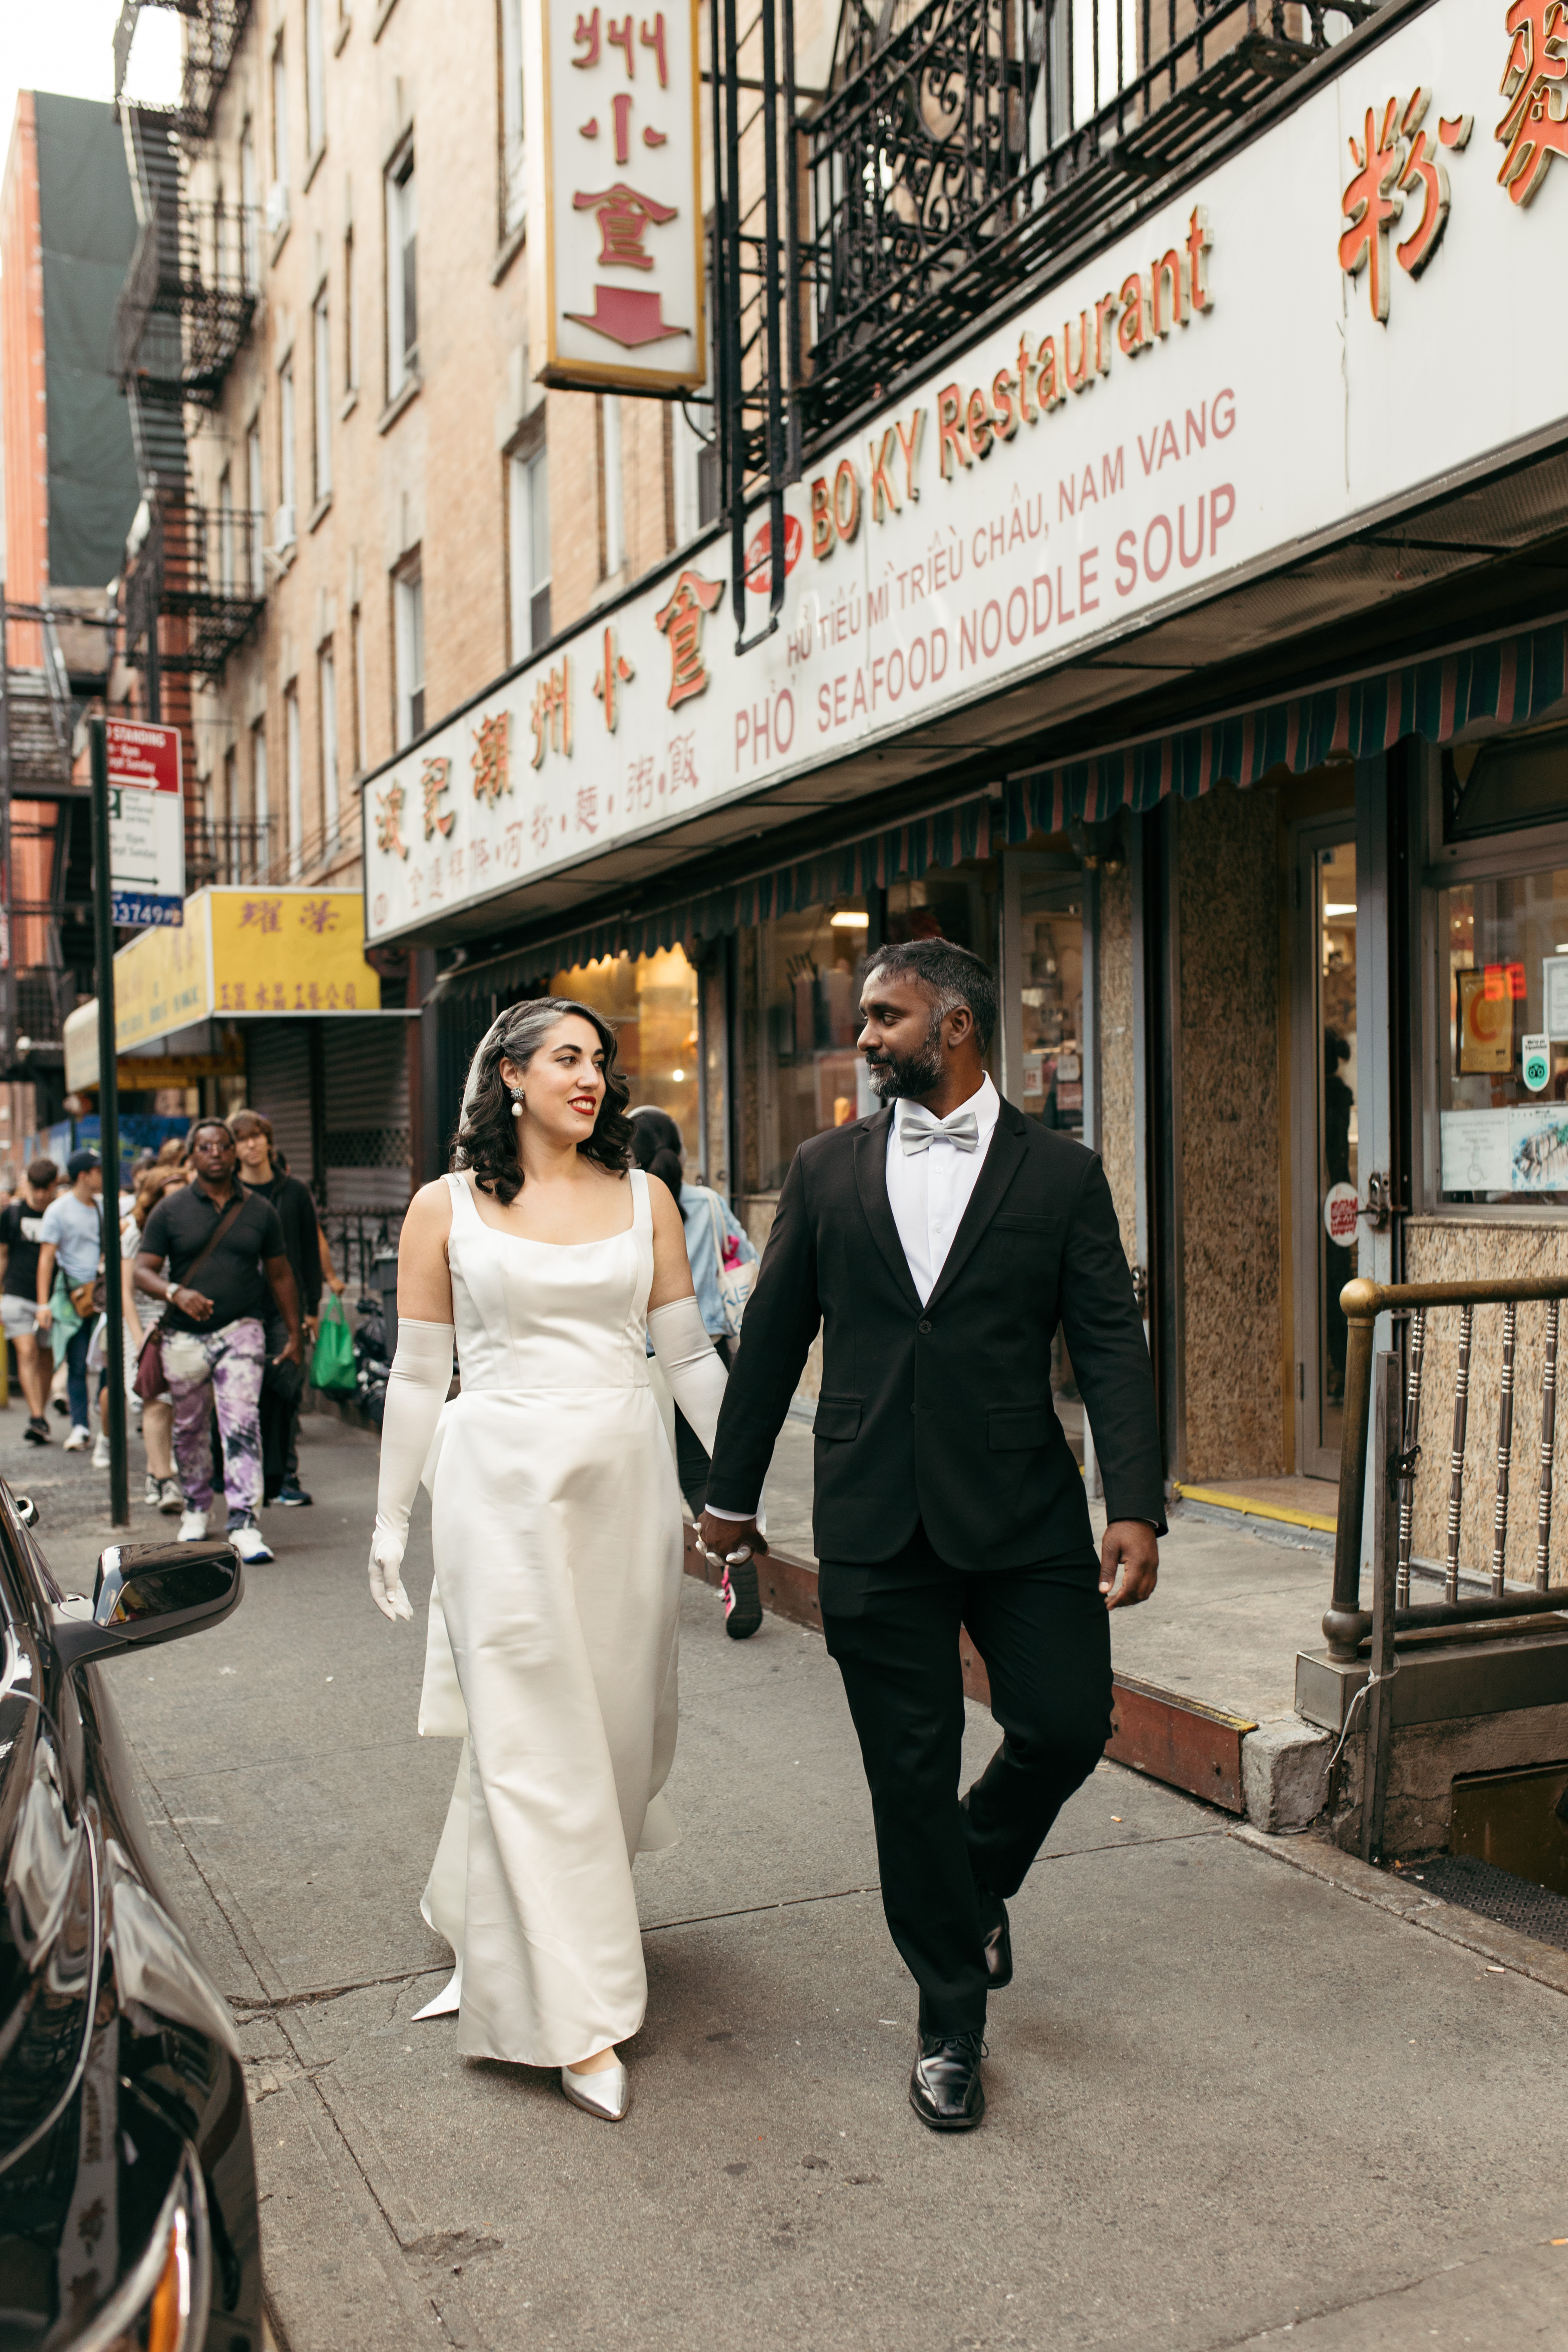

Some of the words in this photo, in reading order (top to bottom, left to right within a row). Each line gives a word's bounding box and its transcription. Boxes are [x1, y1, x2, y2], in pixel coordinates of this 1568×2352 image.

[812, 459, 864, 561] BO
[870, 407, 928, 524] KY
[937, 204, 1215, 482] Restaurant
[1060, 445, 1124, 522] NAM
[1137, 388, 1237, 476] VANG
[818, 627, 948, 733] SEAFOOD
[959, 546, 1100, 671] NOODLE
[1115, 482, 1237, 598] SOUP
